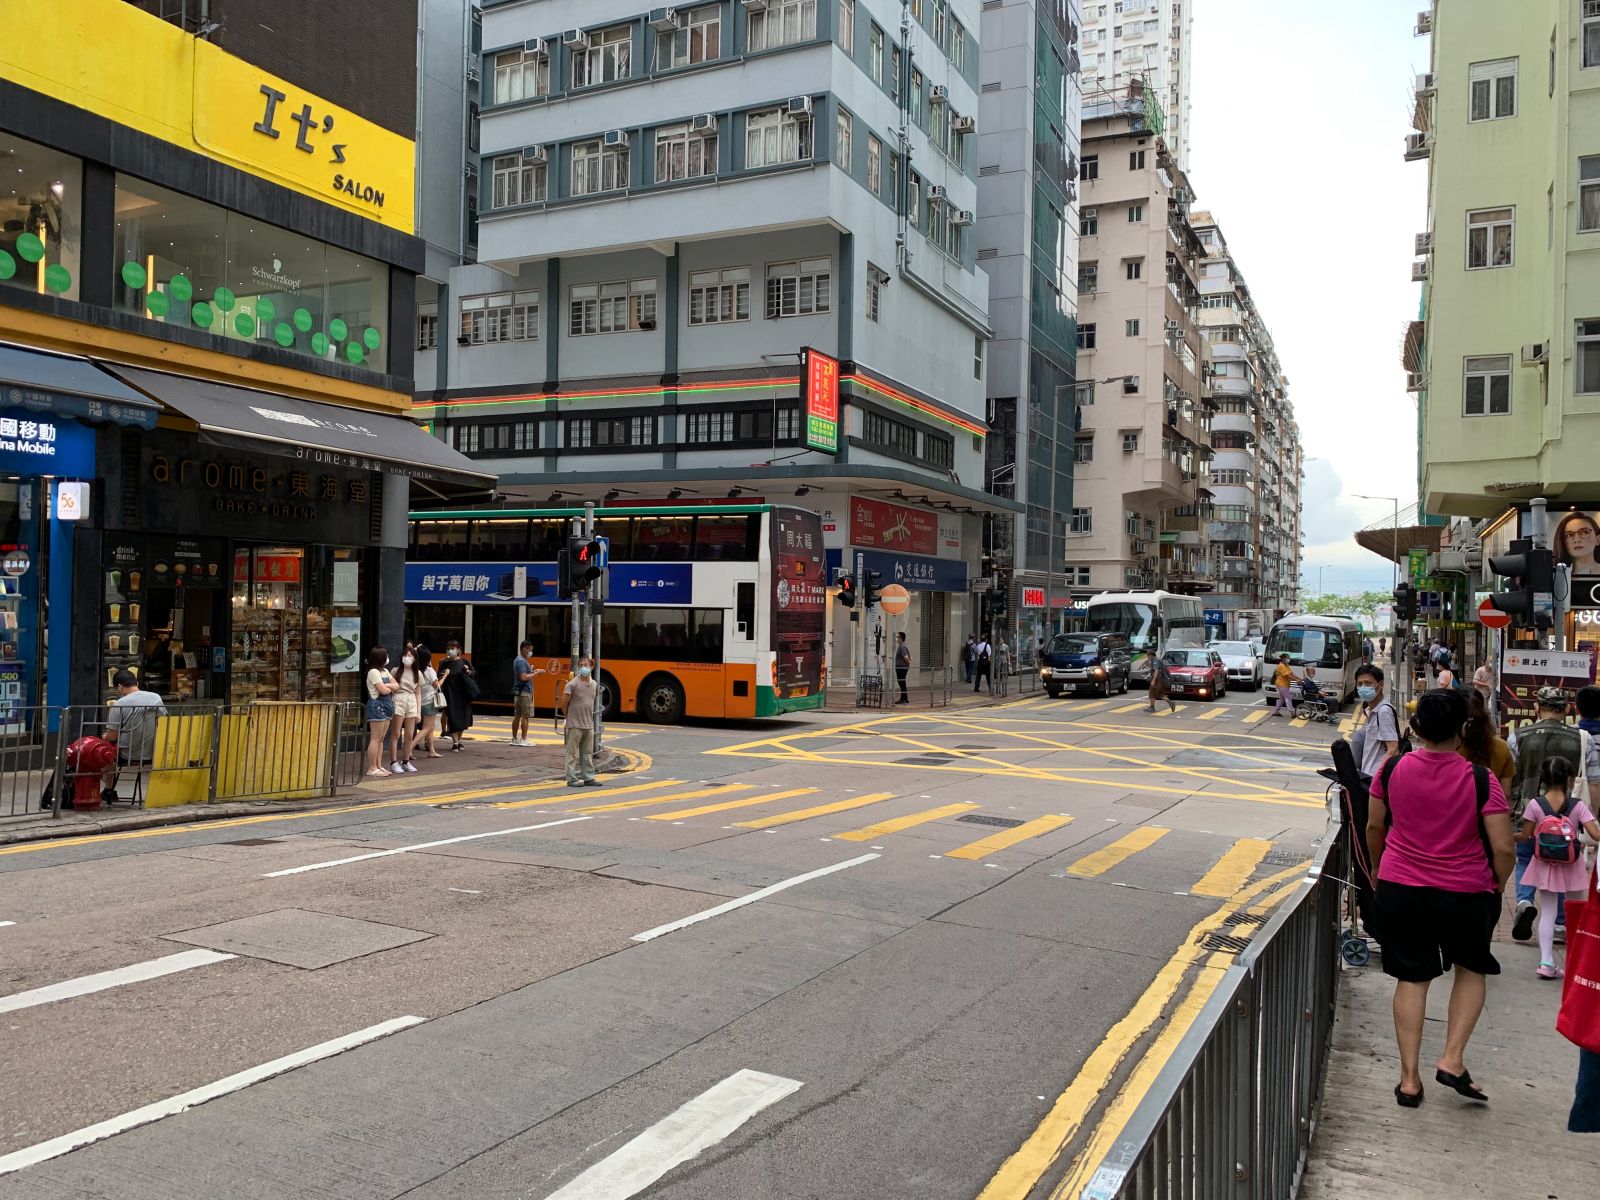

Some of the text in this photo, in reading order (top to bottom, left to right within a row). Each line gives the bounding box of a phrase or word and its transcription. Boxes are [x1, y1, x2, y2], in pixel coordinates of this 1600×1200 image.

[254, 84, 348, 164] It's
[333, 174, 385, 207] SALON
[252, 265, 301, 290] Schwarzkopf
[0, 417, 57, 442] 國移動
[17, 440, 56, 456] Mobile
[296, 446, 340, 465] arome
[153, 455, 368, 503] arome 東海堂
[61, 493, 75, 508] 5G
[787, 531, 812, 549] 周大福
[116, 546, 135, 554] drink
[906, 561, 934, 578] 交通銀行
[422, 575, 490, 592] 與千萬個你
[1427, 592, 1440, 606] P
[1561, 659, 1587, 669] 登記站
